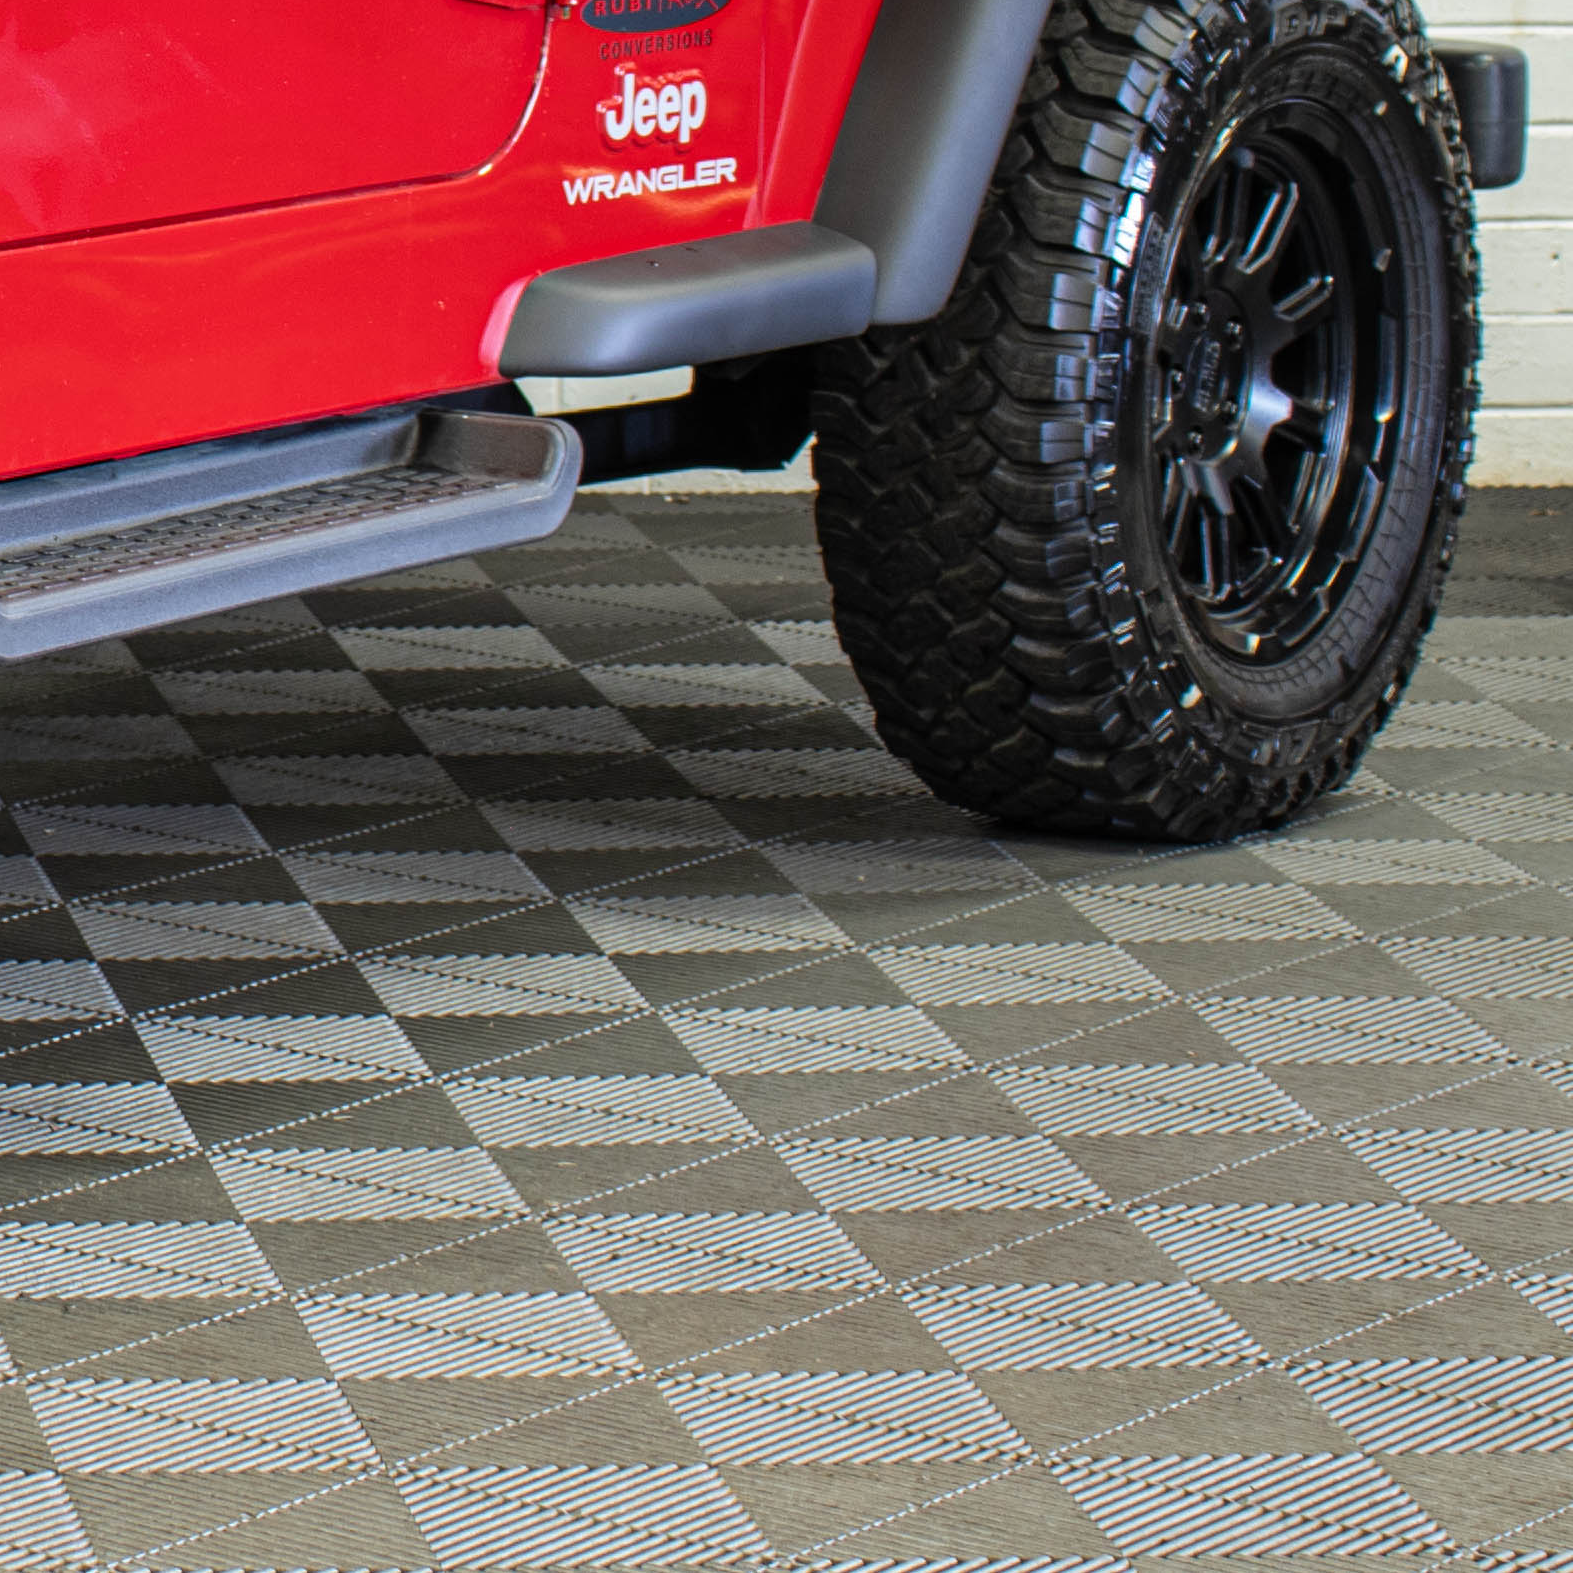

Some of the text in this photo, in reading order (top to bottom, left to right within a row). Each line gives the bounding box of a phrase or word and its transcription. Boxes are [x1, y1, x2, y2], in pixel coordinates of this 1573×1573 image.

[599, 29, 713, 60] CONVERSIONS
[605, 72, 707, 144] Jeep
[562, 157, 737, 205] WRANGLER
